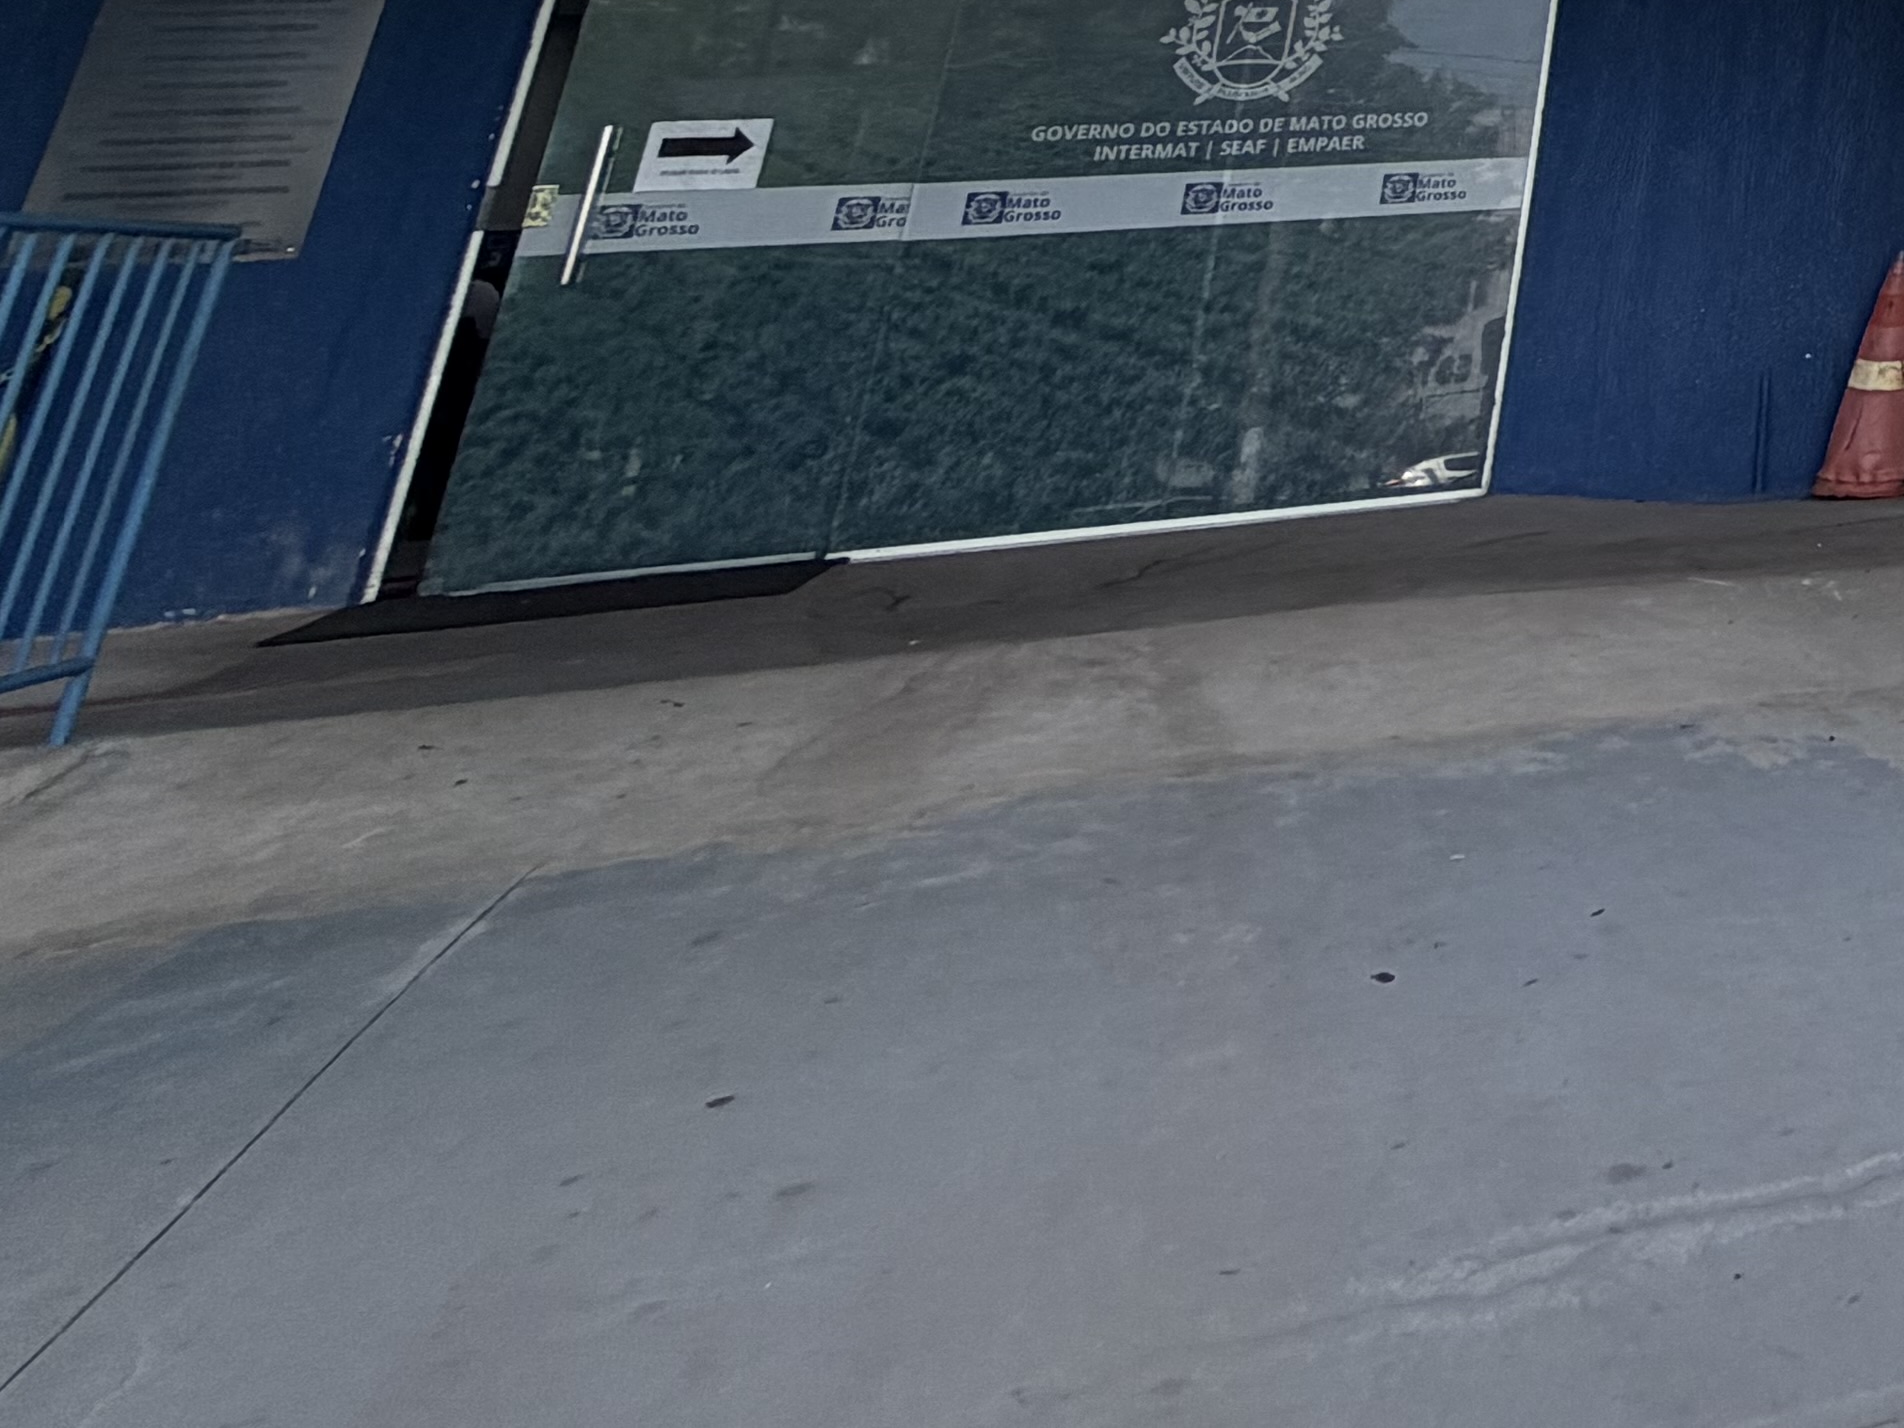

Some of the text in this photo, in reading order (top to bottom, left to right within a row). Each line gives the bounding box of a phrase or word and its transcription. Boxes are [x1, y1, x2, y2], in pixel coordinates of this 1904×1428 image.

[1031, 112, 1428, 142] GOVERNO DO ESTADO DE MATO GROSSO
[1093, 142, 1200, 161] INTERMAT
[1219, 140, 1267, 158] SEAF
[1286, 135, 1364, 154] EMPAER
[1416, 176, 1456, 190] Mato
[1222, 186, 1263, 199] Mato
[1414, 188, 1467, 202] Grosso
[878, 202, 911, 214] Ma
[1005, 196, 1051, 209] Mato
[1219, 199, 1274, 213] Grosso
[637, 209, 688, 223] Mato
[875, 215, 907, 228] Gro
[1003, 208, 1061, 223] Grosso
[634, 224, 699, 238] Grosso
